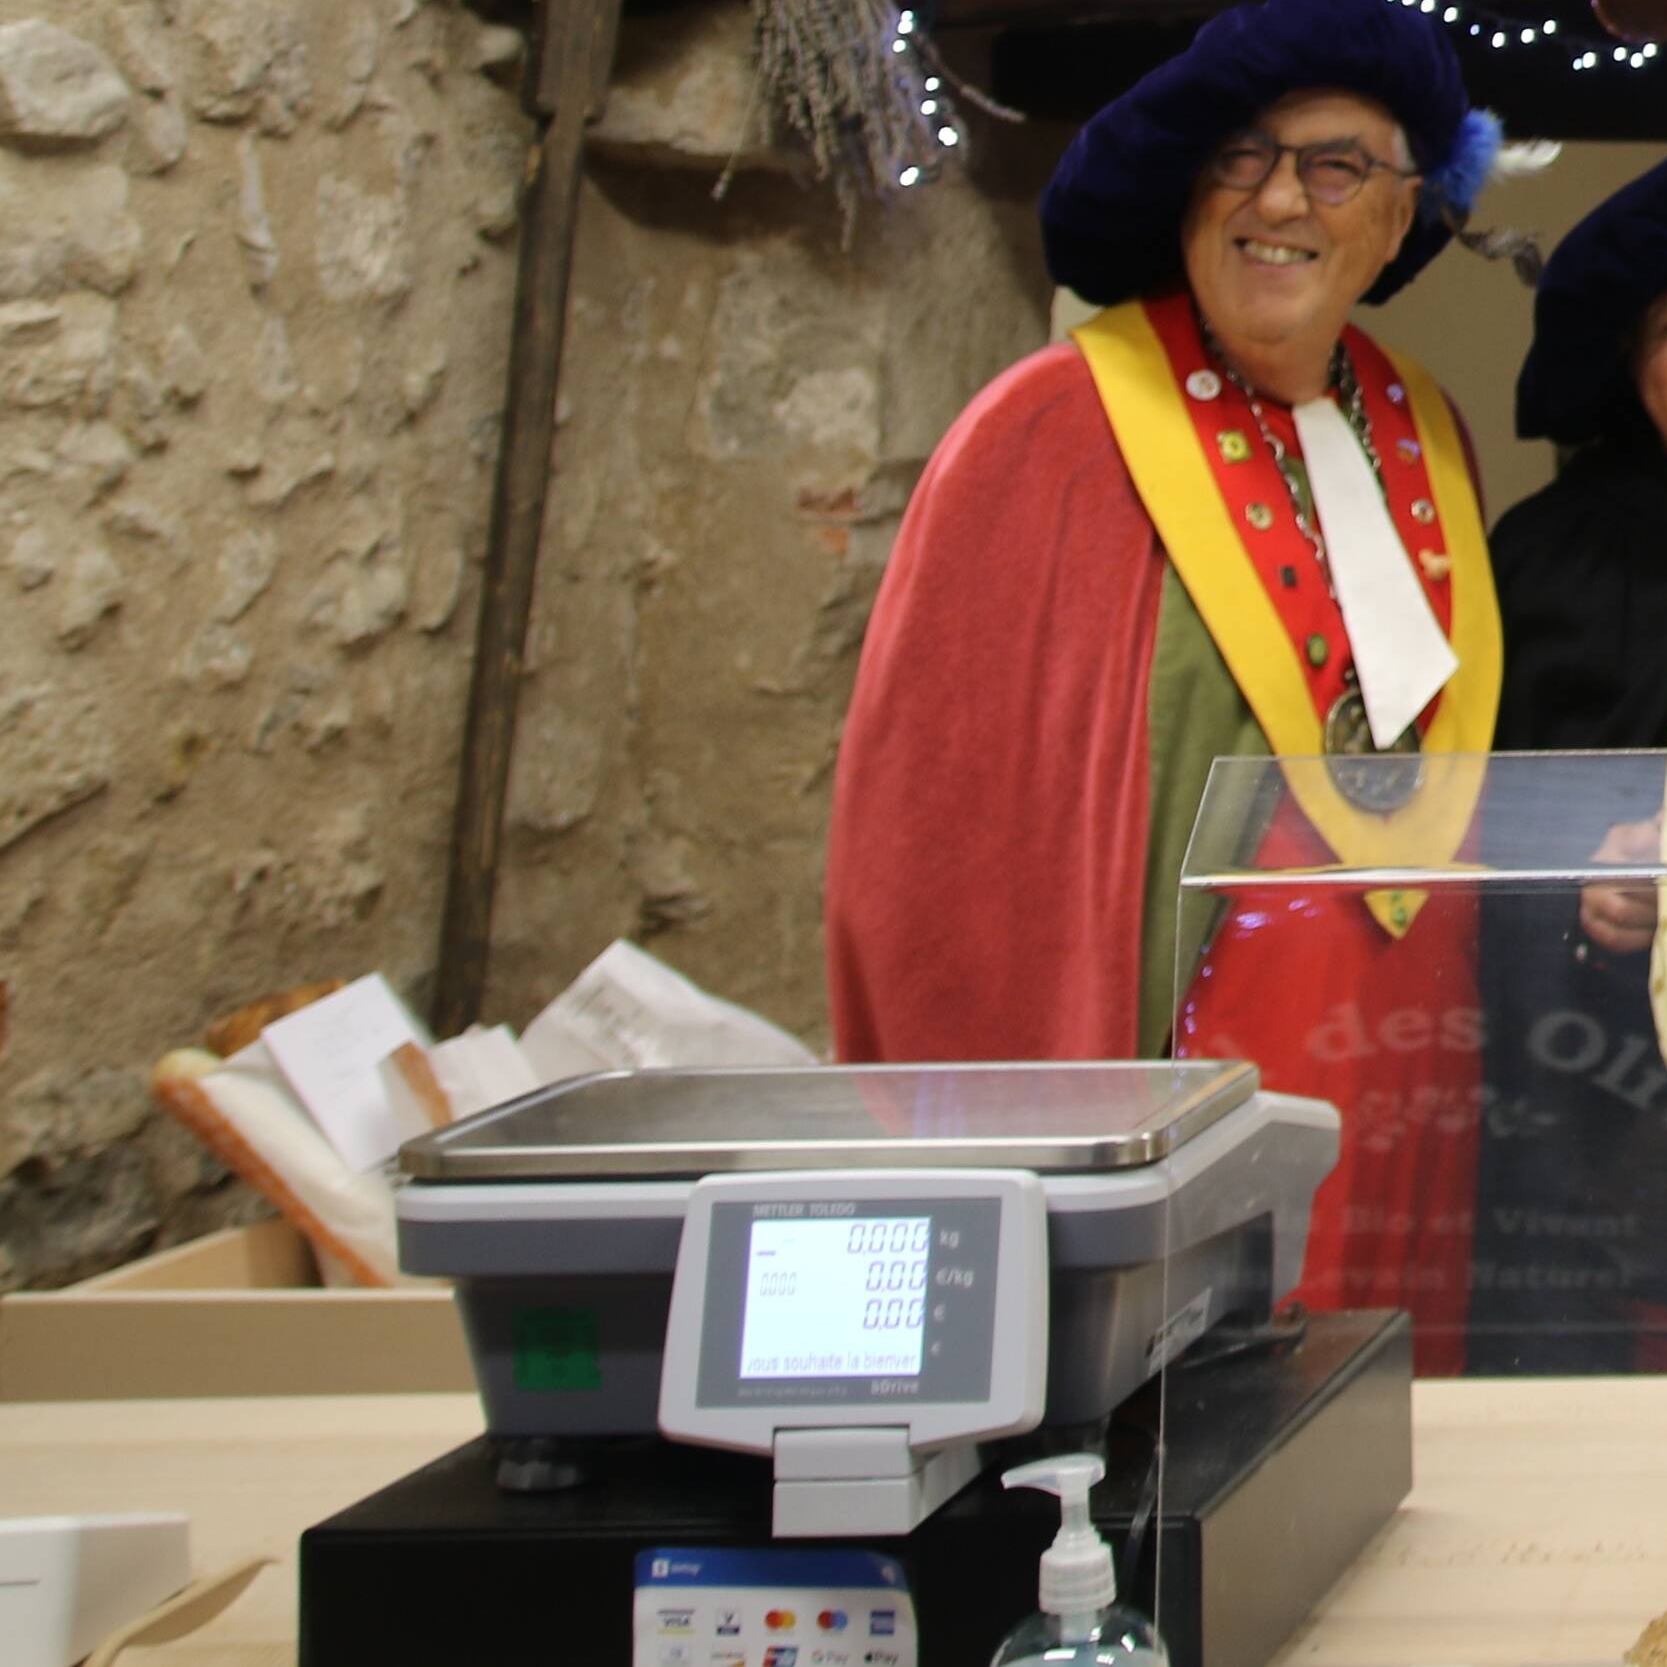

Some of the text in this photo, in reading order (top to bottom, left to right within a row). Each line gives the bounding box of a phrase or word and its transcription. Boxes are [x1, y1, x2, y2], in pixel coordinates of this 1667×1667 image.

[1304, 999, 1489, 1063] des
[752, 1203, 856, 1218] METTLER TOLEDO
[939, 1230, 960, 1249] kg
